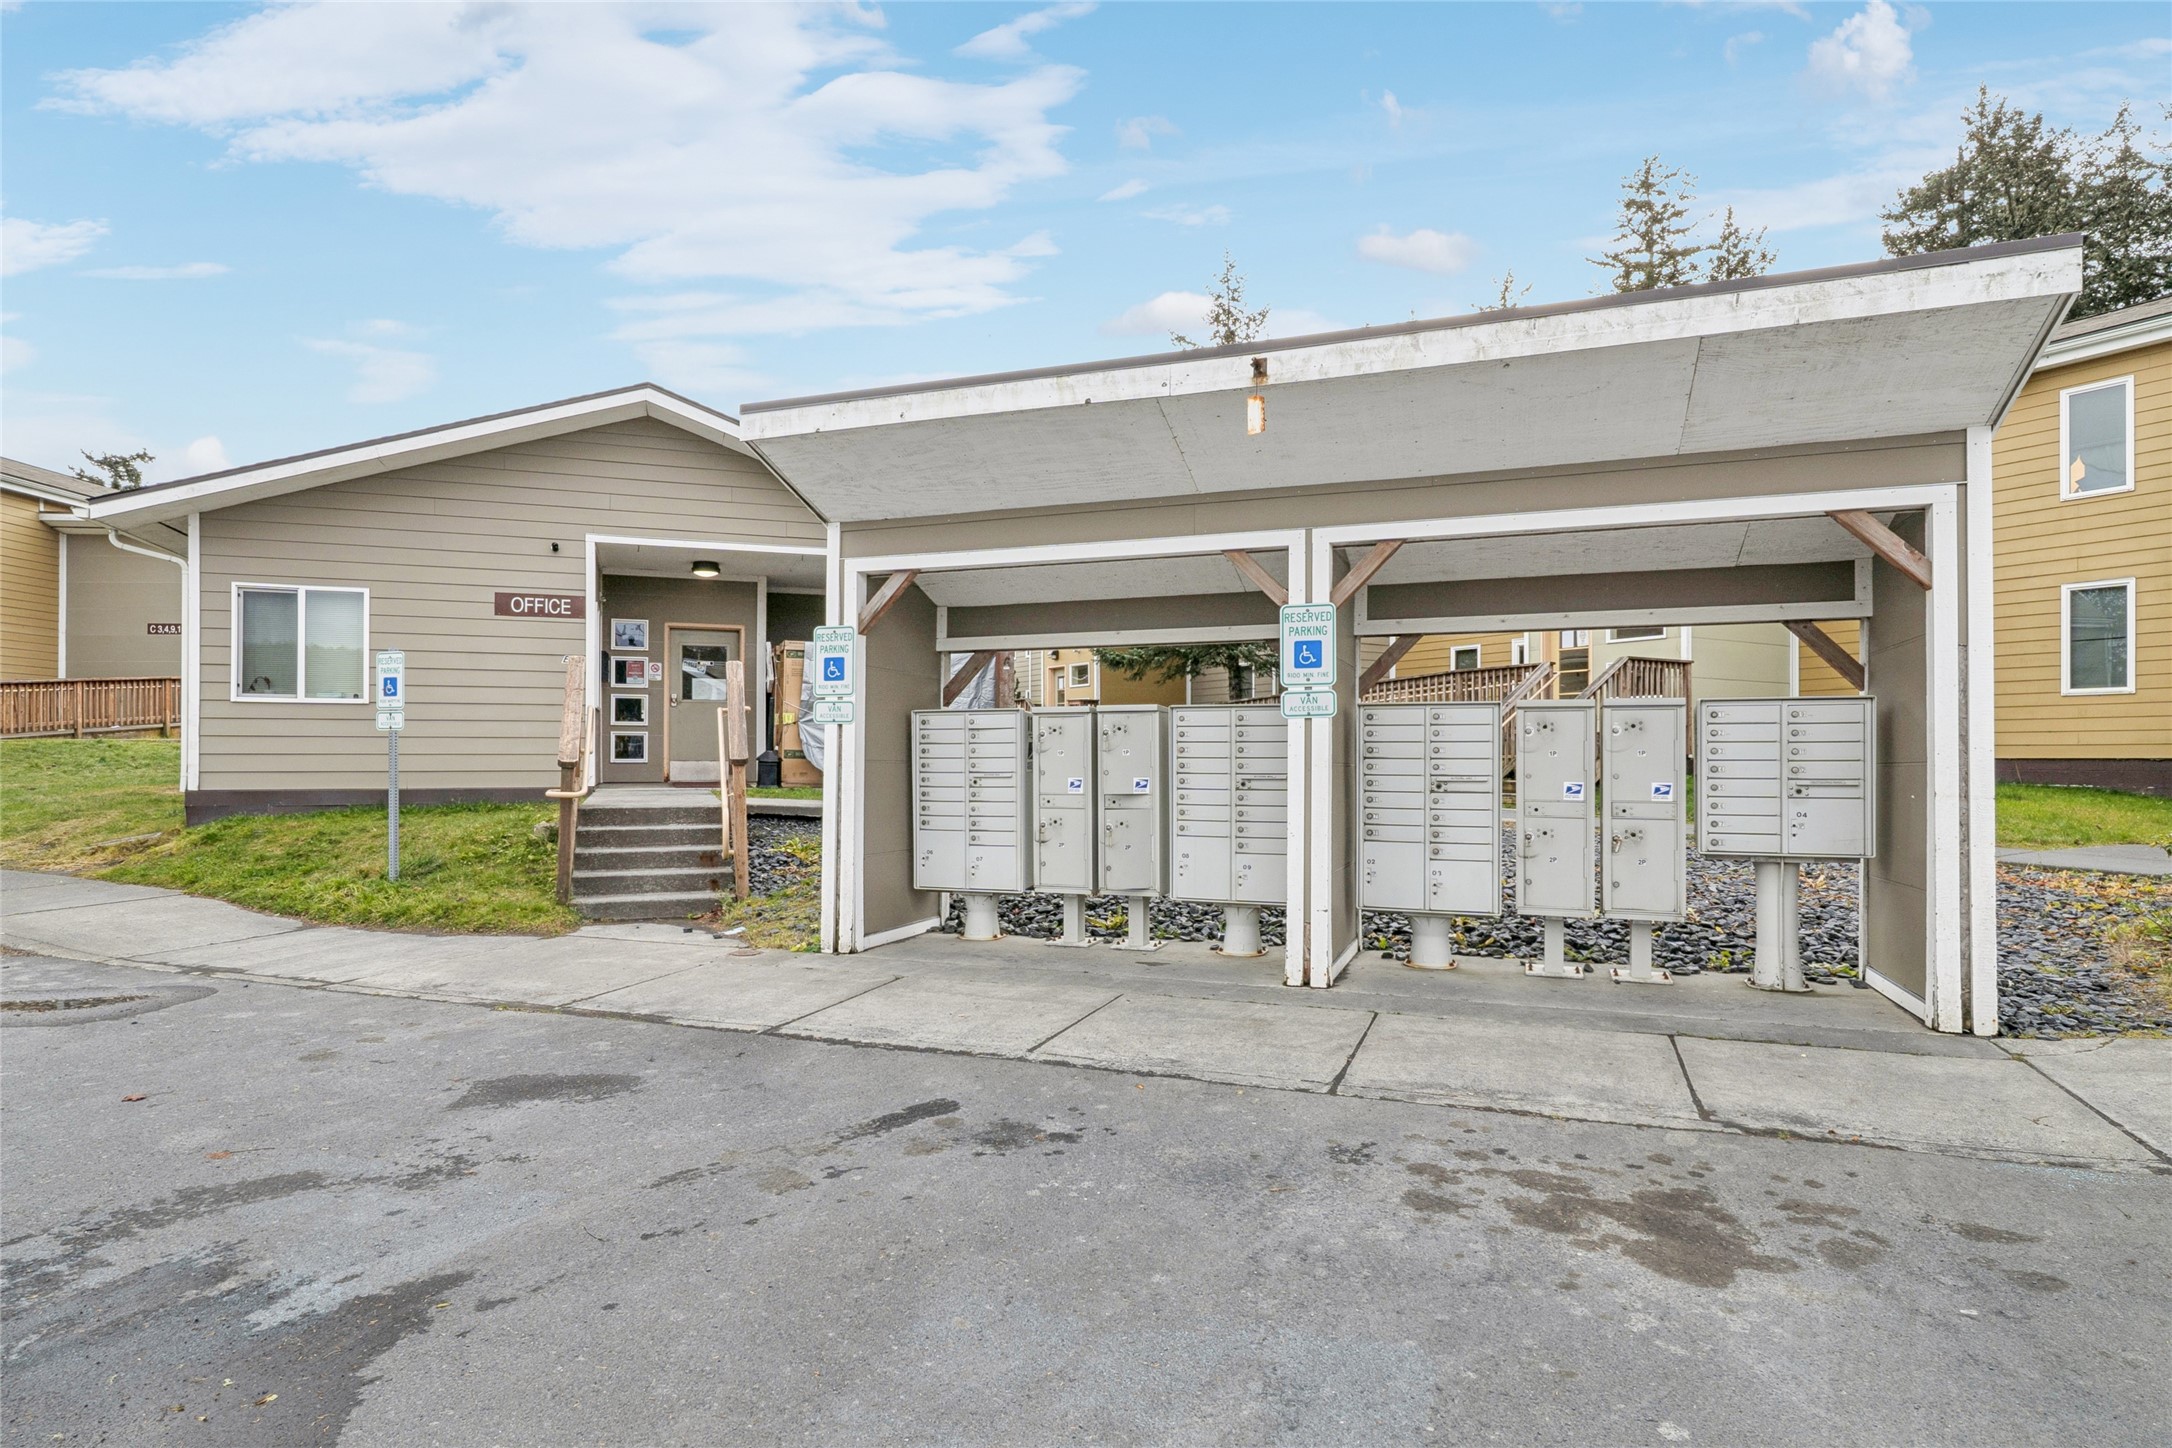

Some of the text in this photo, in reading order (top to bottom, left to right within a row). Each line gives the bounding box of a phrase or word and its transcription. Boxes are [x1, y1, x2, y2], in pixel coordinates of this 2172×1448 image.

[510, 596, 572, 615] OFFICE
[1284, 611, 1332, 622] RESERVED
[150, 625, 156, 633] C
[1288, 625, 1328, 637] PARKING
[816, 632, 853, 643] RESERVED
[820, 644, 849, 654] PARKING
[1300, 697, 1318, 705] VAN
[828, 705, 842, 713] VAN
[1796, 811, 1808, 819] 04
[1366, 858, 1376, 866] 02
[1638, 859, 1647, 867] 2P
